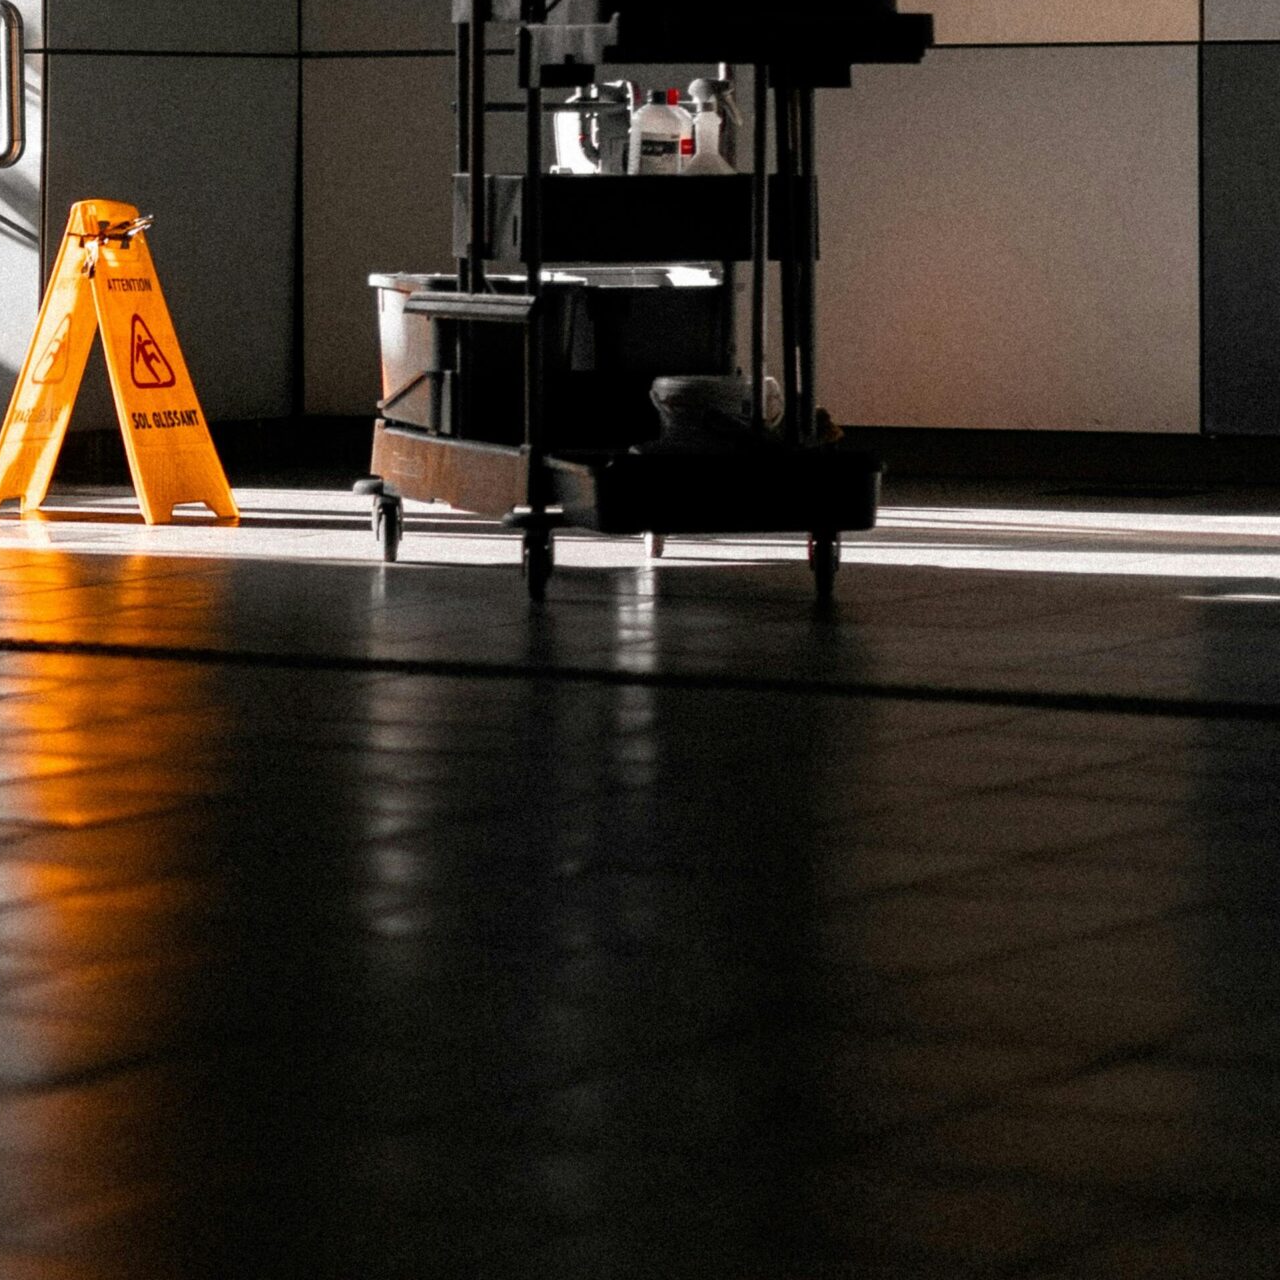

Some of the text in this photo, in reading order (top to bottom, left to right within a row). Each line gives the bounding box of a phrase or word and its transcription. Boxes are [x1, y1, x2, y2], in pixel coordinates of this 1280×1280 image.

[107, 277, 153, 292] ATTENTION
[131, 409, 200, 429] SOL GLISSANT
